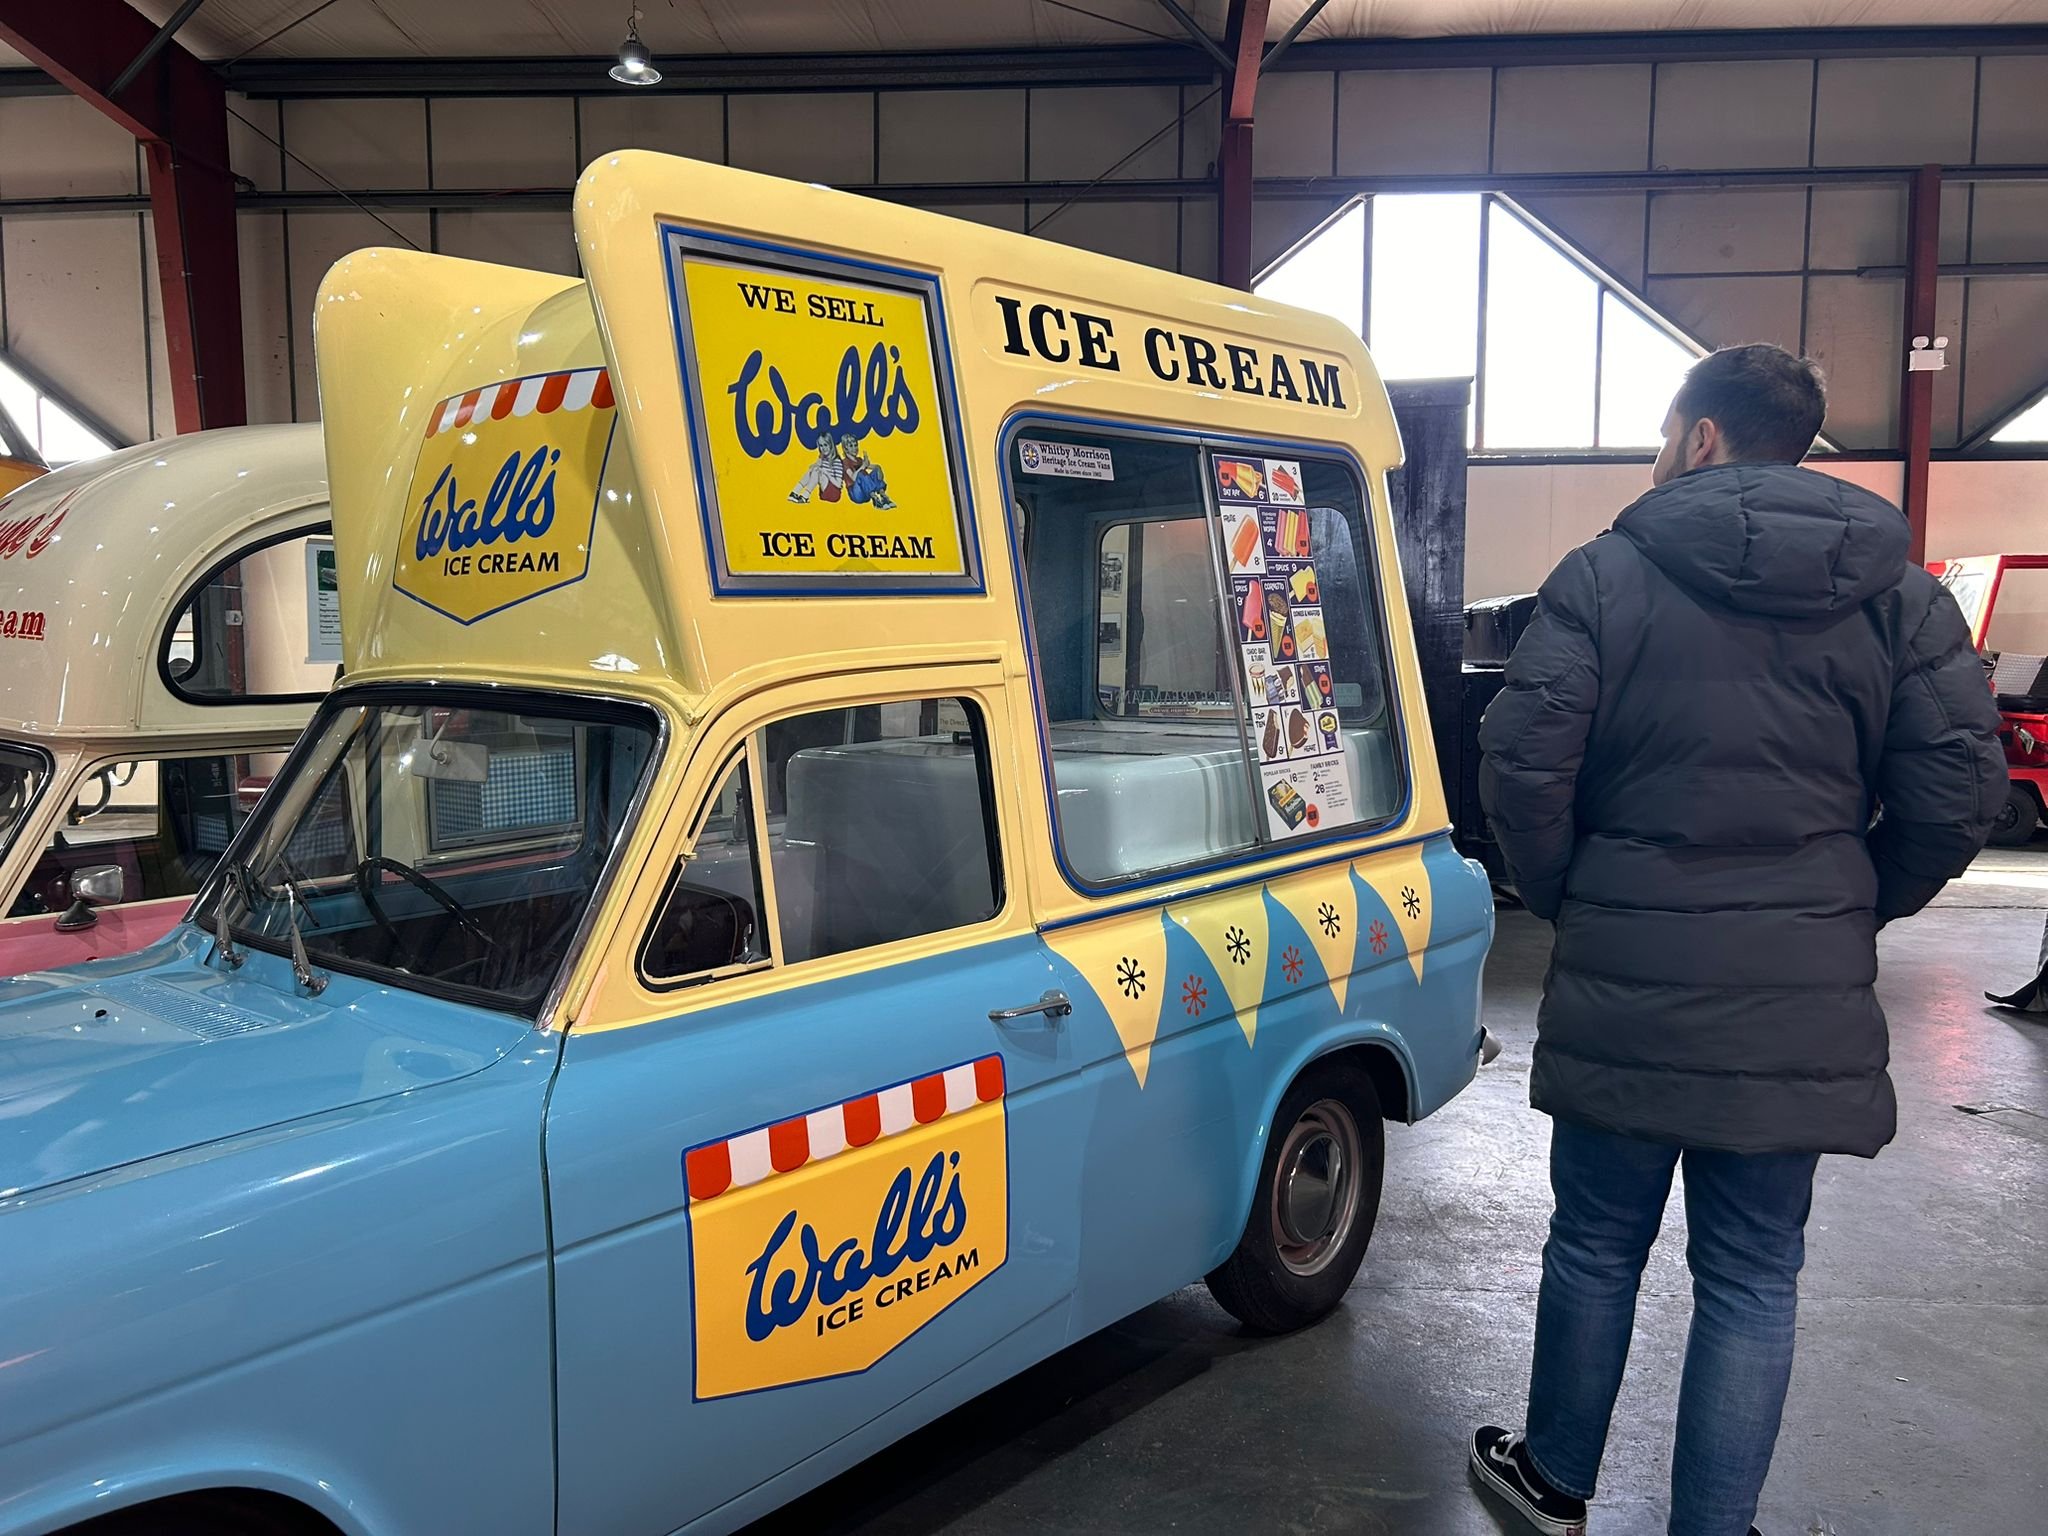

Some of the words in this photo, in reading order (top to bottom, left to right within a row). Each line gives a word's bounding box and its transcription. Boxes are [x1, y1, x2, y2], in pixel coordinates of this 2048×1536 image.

[737, 282, 796, 314] WE
[807, 294, 884, 327] SELL
[995, 295, 1120, 372] ICE
[1144, 327, 1347, 410] CREAM
[727, 341, 920, 458] Wall's
[1039, 444, 1070, 458] Whitby
[1072, 447, 1110, 460] Morrison
[1042, 456, 1066, 467] Heritage
[1068, 458, 1077, 466] Ice
[1078, 460, 1096, 468] Cream
[1097, 462, 1111, 470] Vans
[415, 444, 561, 561] Wall's
[443, 556, 472, 576] ICE
[477, 552, 560, 574] CREAM
[759, 532, 815, 557] ICE
[827, 534, 936, 559] CREAM
[745, 1150, 967, 1342] Wall's
[816, 1298, 864, 1337] ICE
[875, 1248, 980, 1308] CREAM
